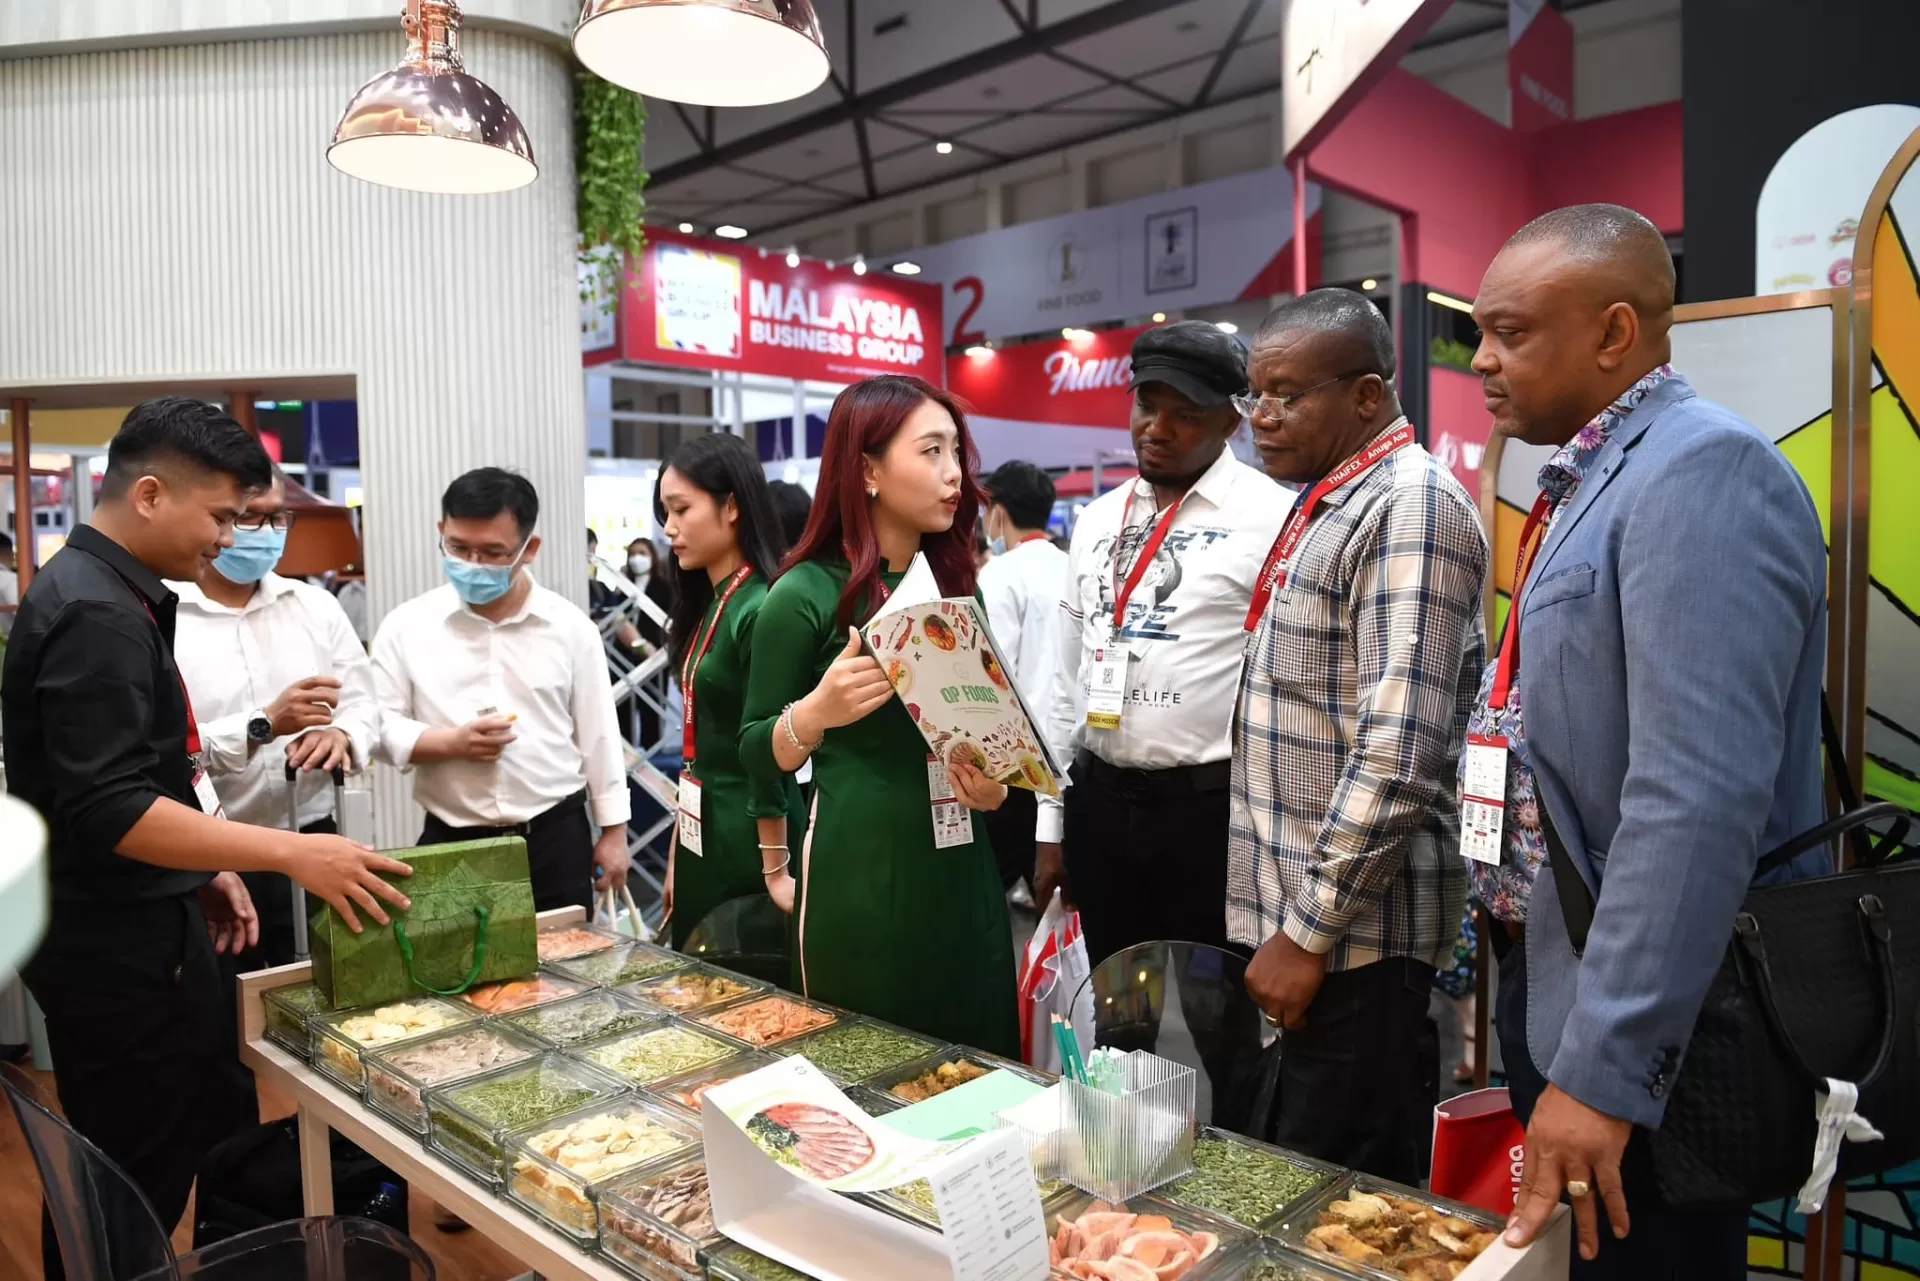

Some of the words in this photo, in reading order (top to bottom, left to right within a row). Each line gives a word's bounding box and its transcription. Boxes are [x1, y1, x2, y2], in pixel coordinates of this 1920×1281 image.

[750, 279, 924, 342] MALAYSIA
[952, 276, 985, 345] 2
[750, 320, 854, 357] BUSINESS
[857, 336, 925, 365] GROUP
[1043, 351, 1134, 396] Franc
[1327, 459, 1364, 485] THAIFEX
[1367, 439, 1394, 460] Anuga
[1391, 430, 1409, 446] Asia
[1281, 526, 1299, 556] Anuga
[1293, 514, 1306, 531] Asia
[960, 684, 999, 704] FOODS
